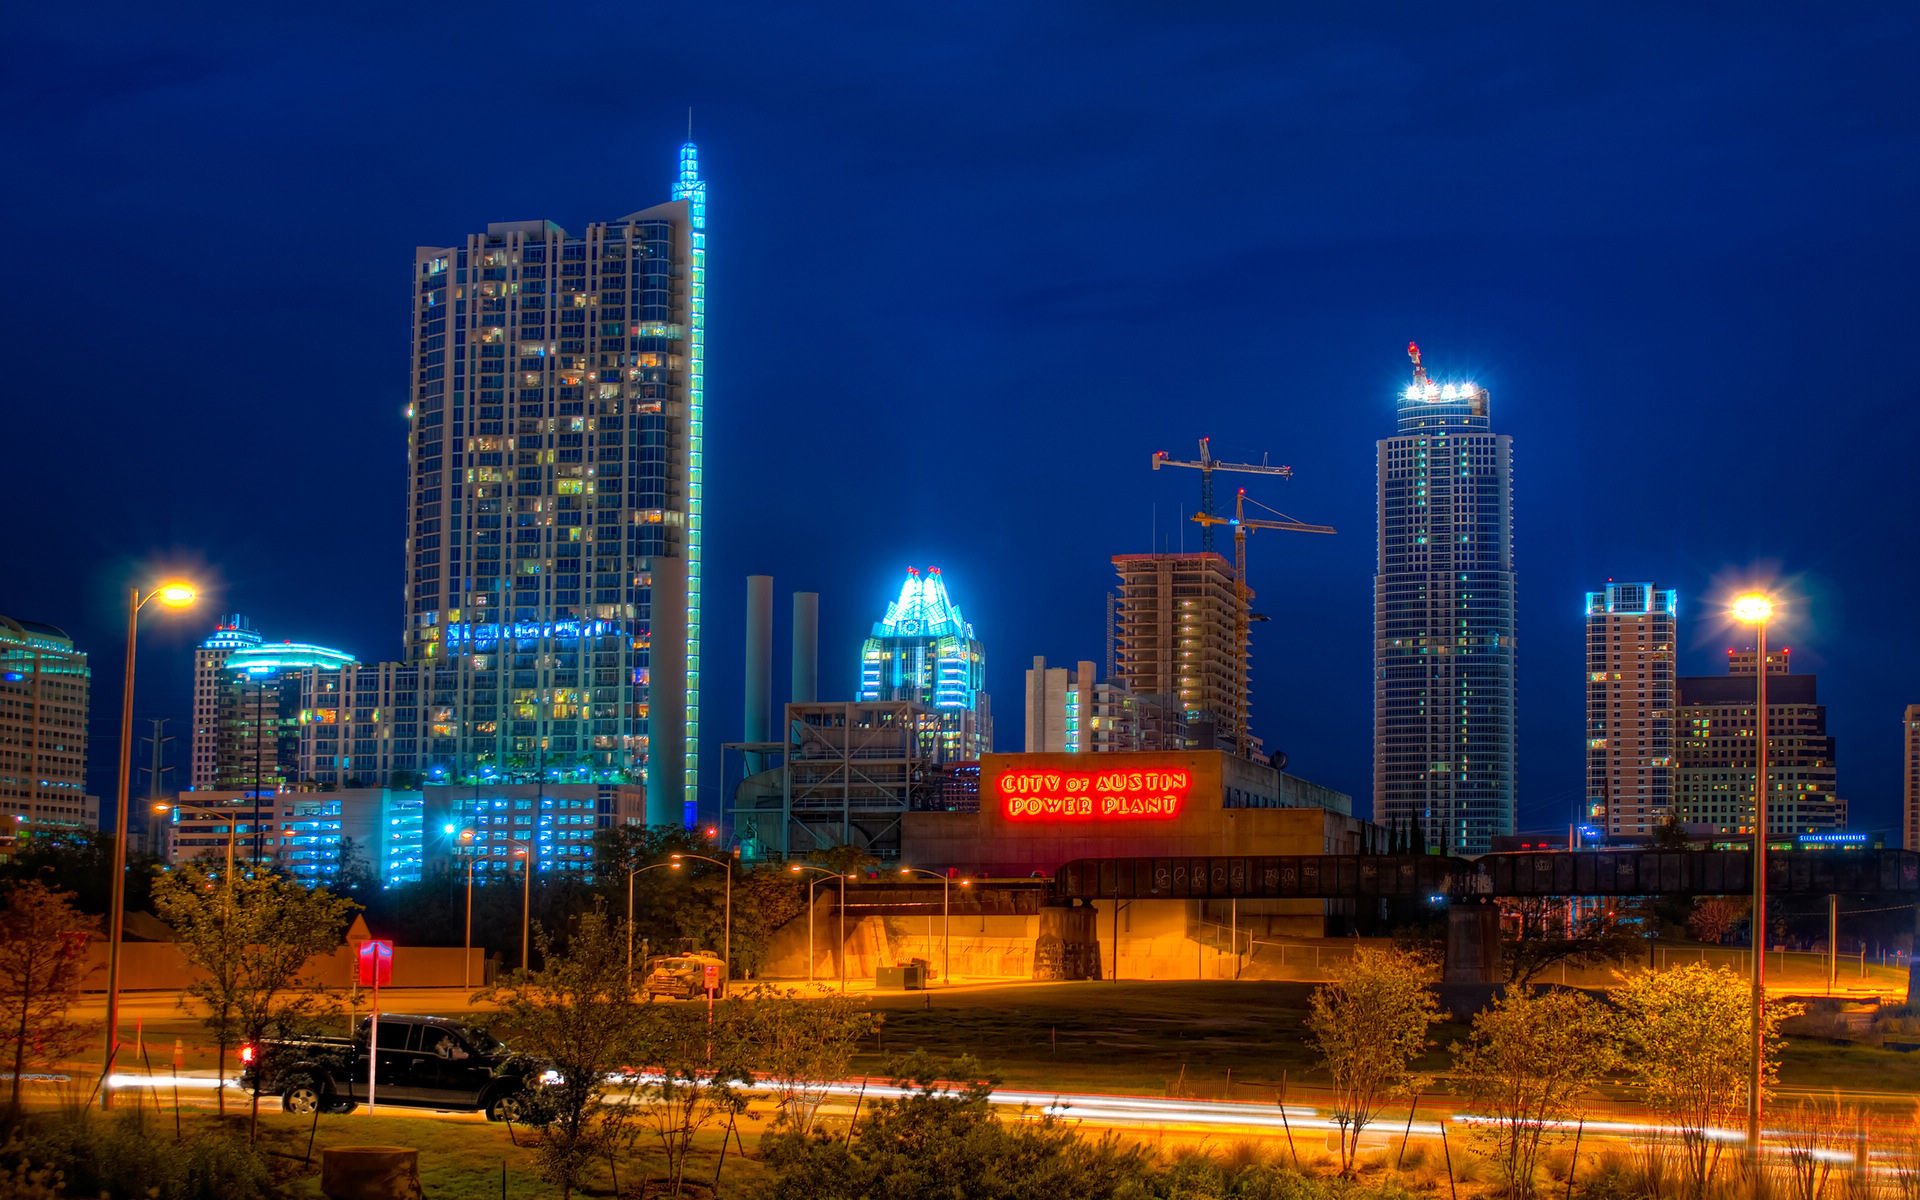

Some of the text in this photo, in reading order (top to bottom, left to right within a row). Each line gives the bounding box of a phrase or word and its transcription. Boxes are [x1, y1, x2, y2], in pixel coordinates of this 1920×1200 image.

[1001, 773, 1187, 793] CITY OF AUSTIN
[1008, 795, 1177, 816] POWER PLANT
